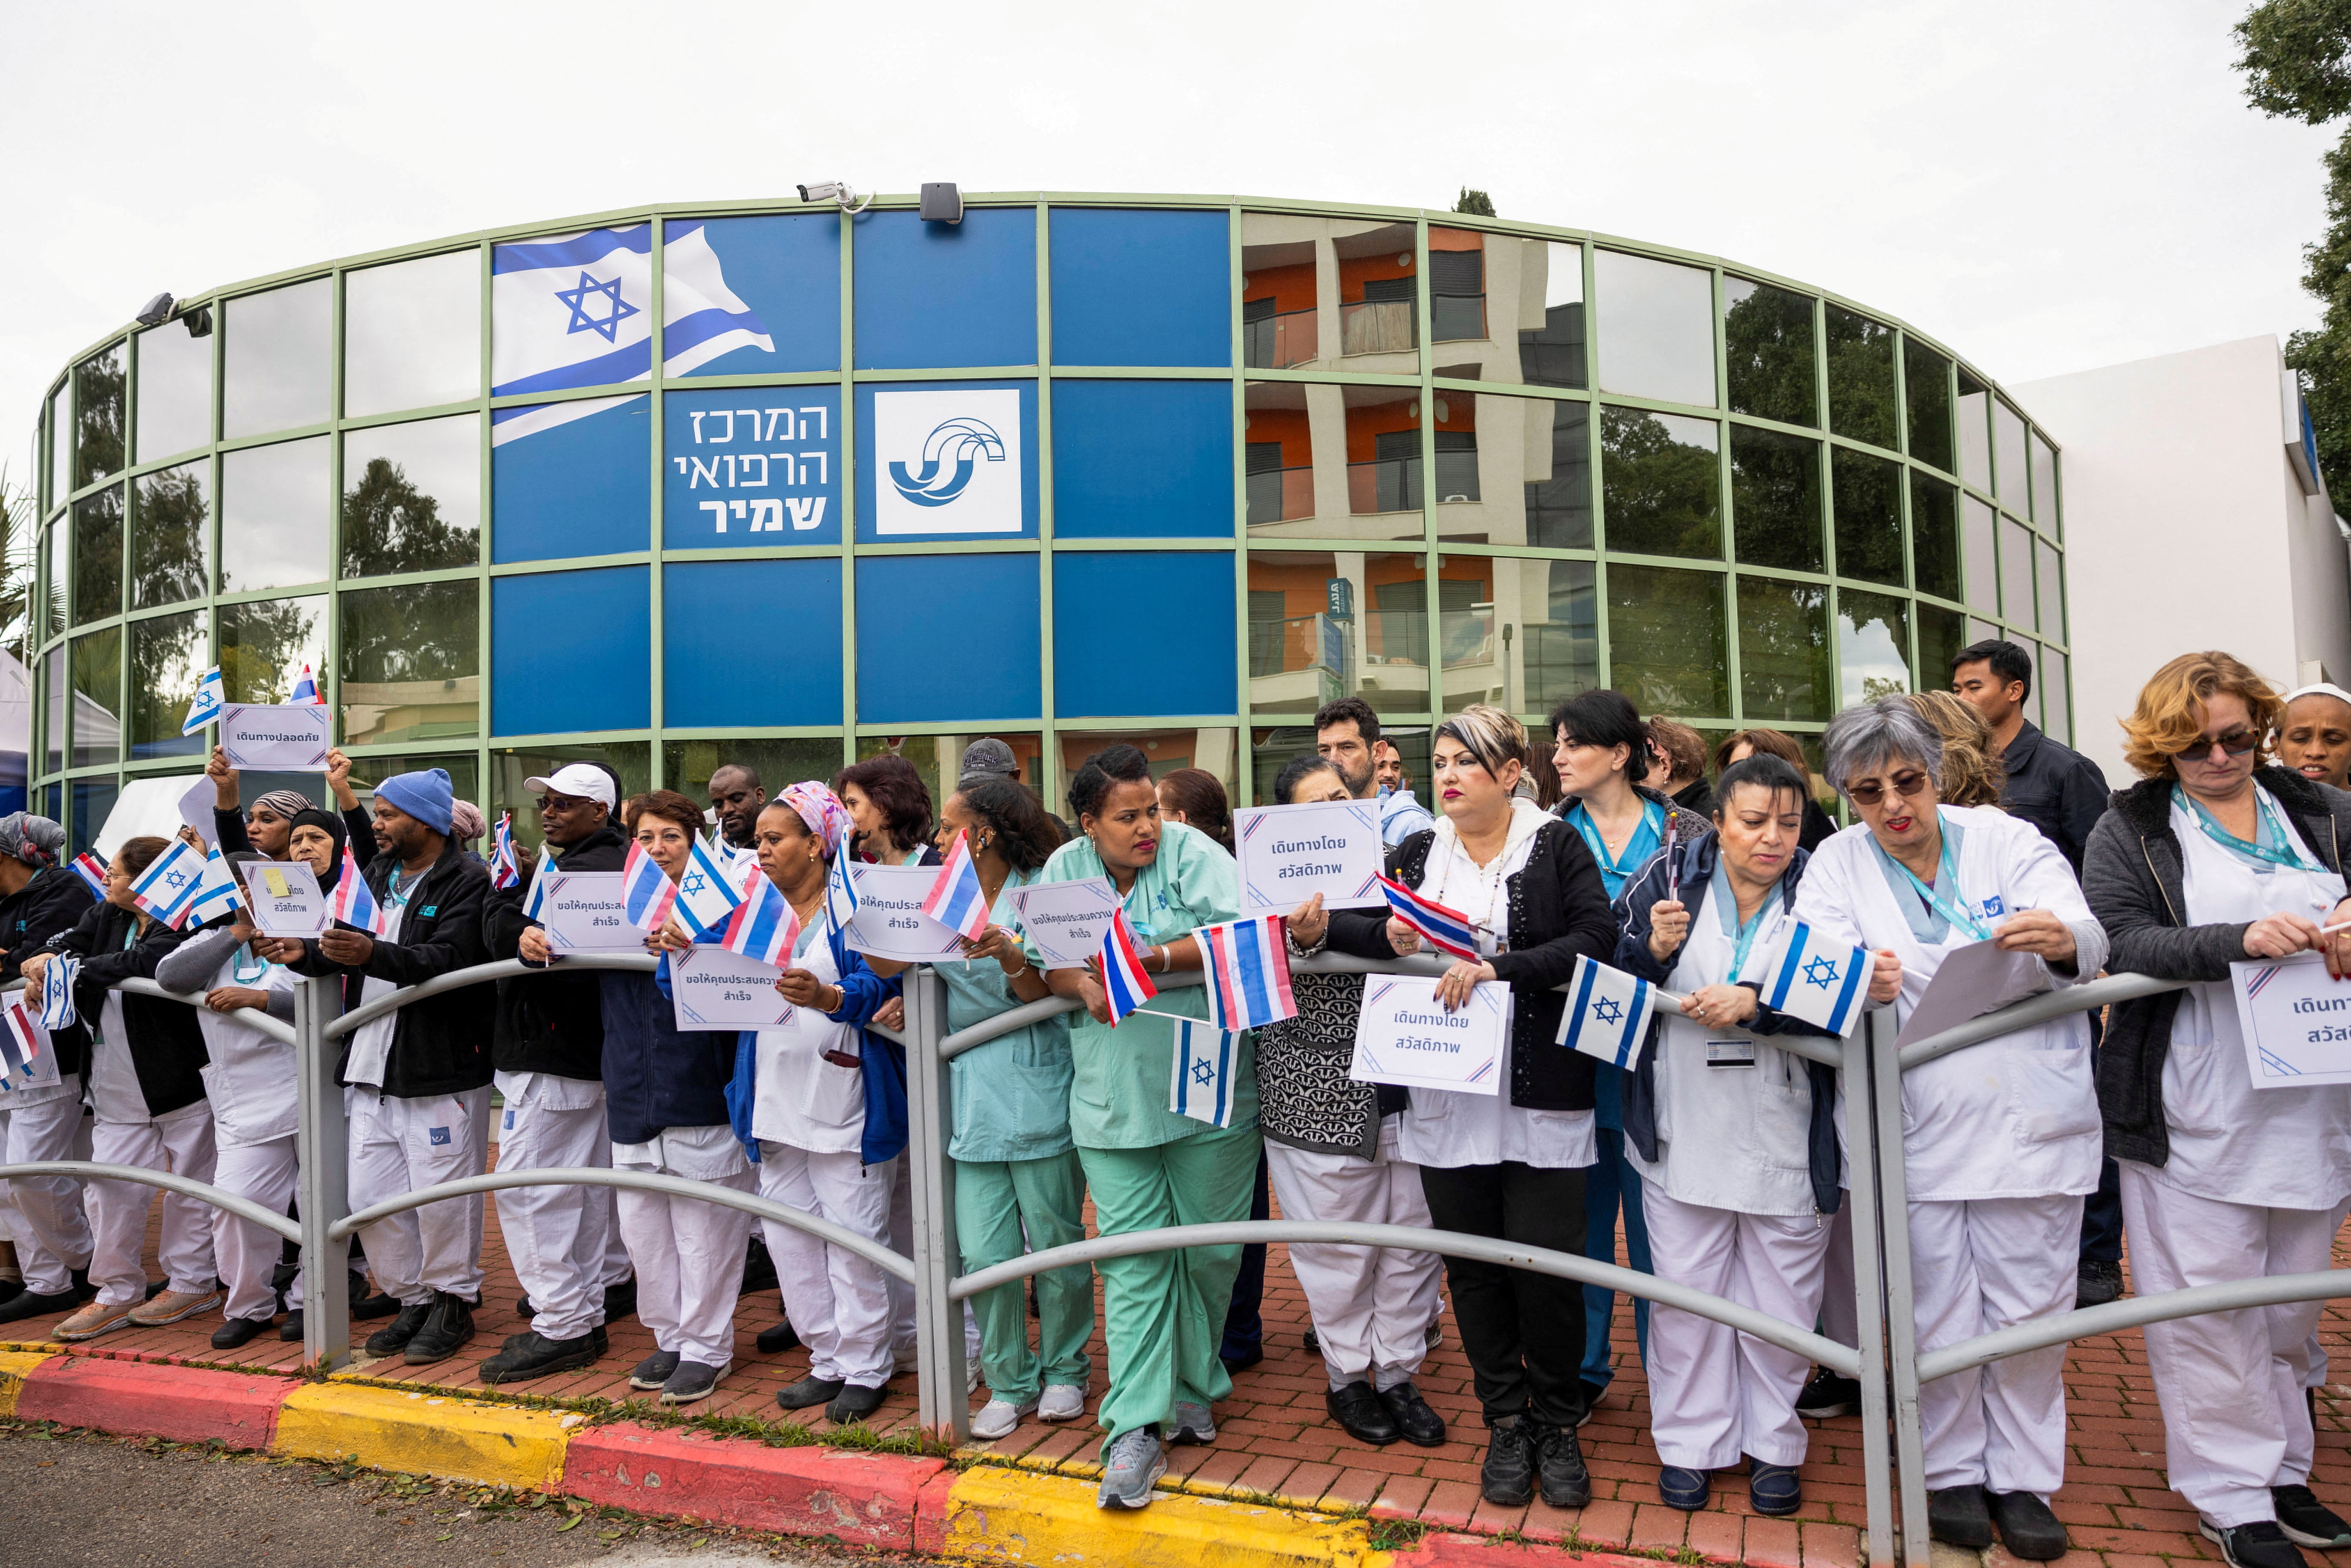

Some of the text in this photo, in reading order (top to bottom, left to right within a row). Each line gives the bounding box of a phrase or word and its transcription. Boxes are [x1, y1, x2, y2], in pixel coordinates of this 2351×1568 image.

[689, 407, 827, 444] המרכז
[674, 451, 827, 489] הרפואי
[699, 496, 827, 533] שמיר
[236, 732, 319, 742] เดินทางปลอดภัย
[1272, 835, 1346, 854] เดินทางโดย
[1279, 863, 1342, 878] สวัสดิภาพ
[274, 902, 307, 912] สวัสดิภาพ
[592, 916, 619, 926] สำเร็จ
[889, 917, 919, 928] สำเร็จ
[1031, 910, 1113, 925] ขอให้คุณประสบความ
[1069, 928, 1091, 938] สำเร็จ
[686, 973, 777, 986] ขอให้คุณประสบควา
[724, 990, 751, 1001] สำเร็จ
[1394, 1011, 1469, 1028] เดินทางโดย
[2308, 1025, 2351, 1043] สวัส
[1396, 1035, 1461, 1053] สวัสดิภาพ
